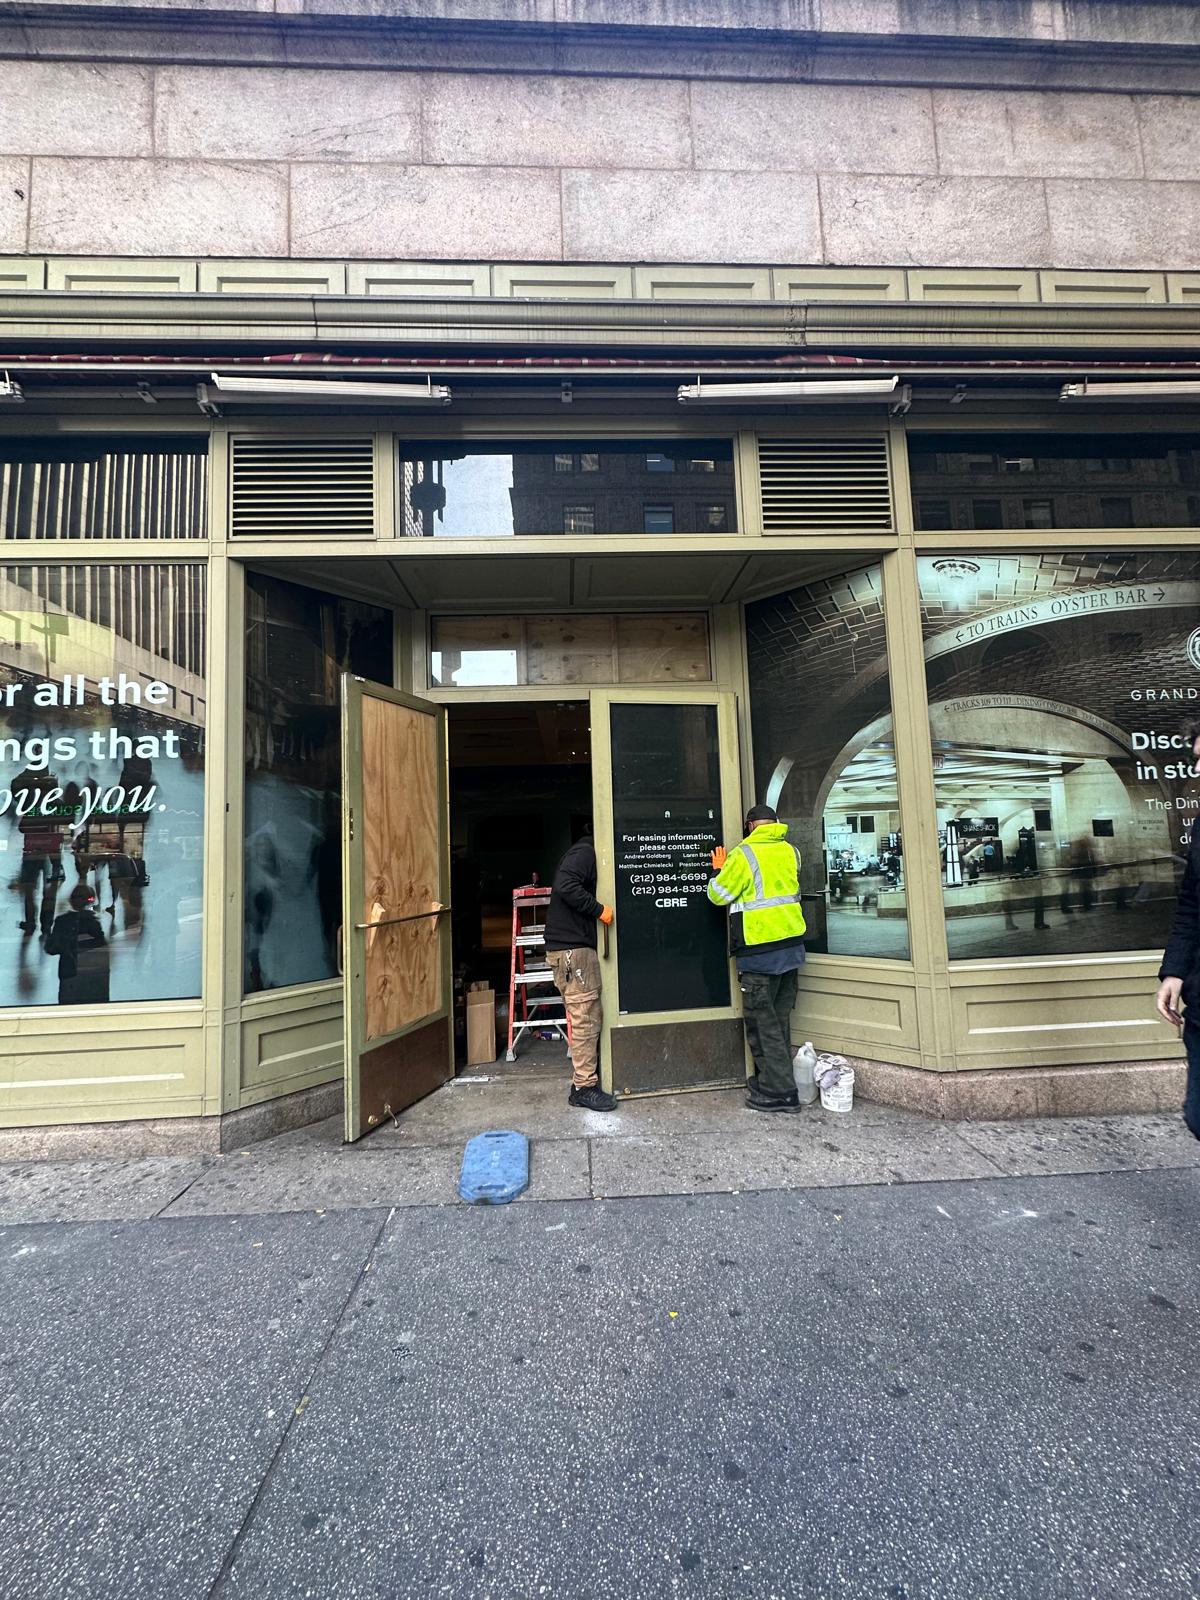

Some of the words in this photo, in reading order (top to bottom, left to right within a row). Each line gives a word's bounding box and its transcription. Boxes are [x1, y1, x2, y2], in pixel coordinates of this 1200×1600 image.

[1051, 592, 1109, 615] OYSTER
[1115, 588, 1147, 605] BAR
[967, 622, 984, 638] TO
[987, 606, 1038, 630] TRAINS
[34, 674, 85, 707] all
[98, 674, 169, 705] the
[1131, 688, 1197, 700] GRAND
[951, 700, 980, 711] TRACKS
[89, 728, 179, 760] that
[1136, 761, 1158, 779] in
[69, 785, 167, 829] you.
[1145, 798, 1172, 810] The
[637, 834, 667, 843] leasing
[668, 833, 716, 841] information,
[640, 844, 666, 852] please
[630, 874, 655, 884] (212)
[656, 873, 707, 882] 984-6698
[631, 885, 656, 896] (212)
[657, 884, 708, 894] 984-8393
[655, 897, 688, 908] CBRE
